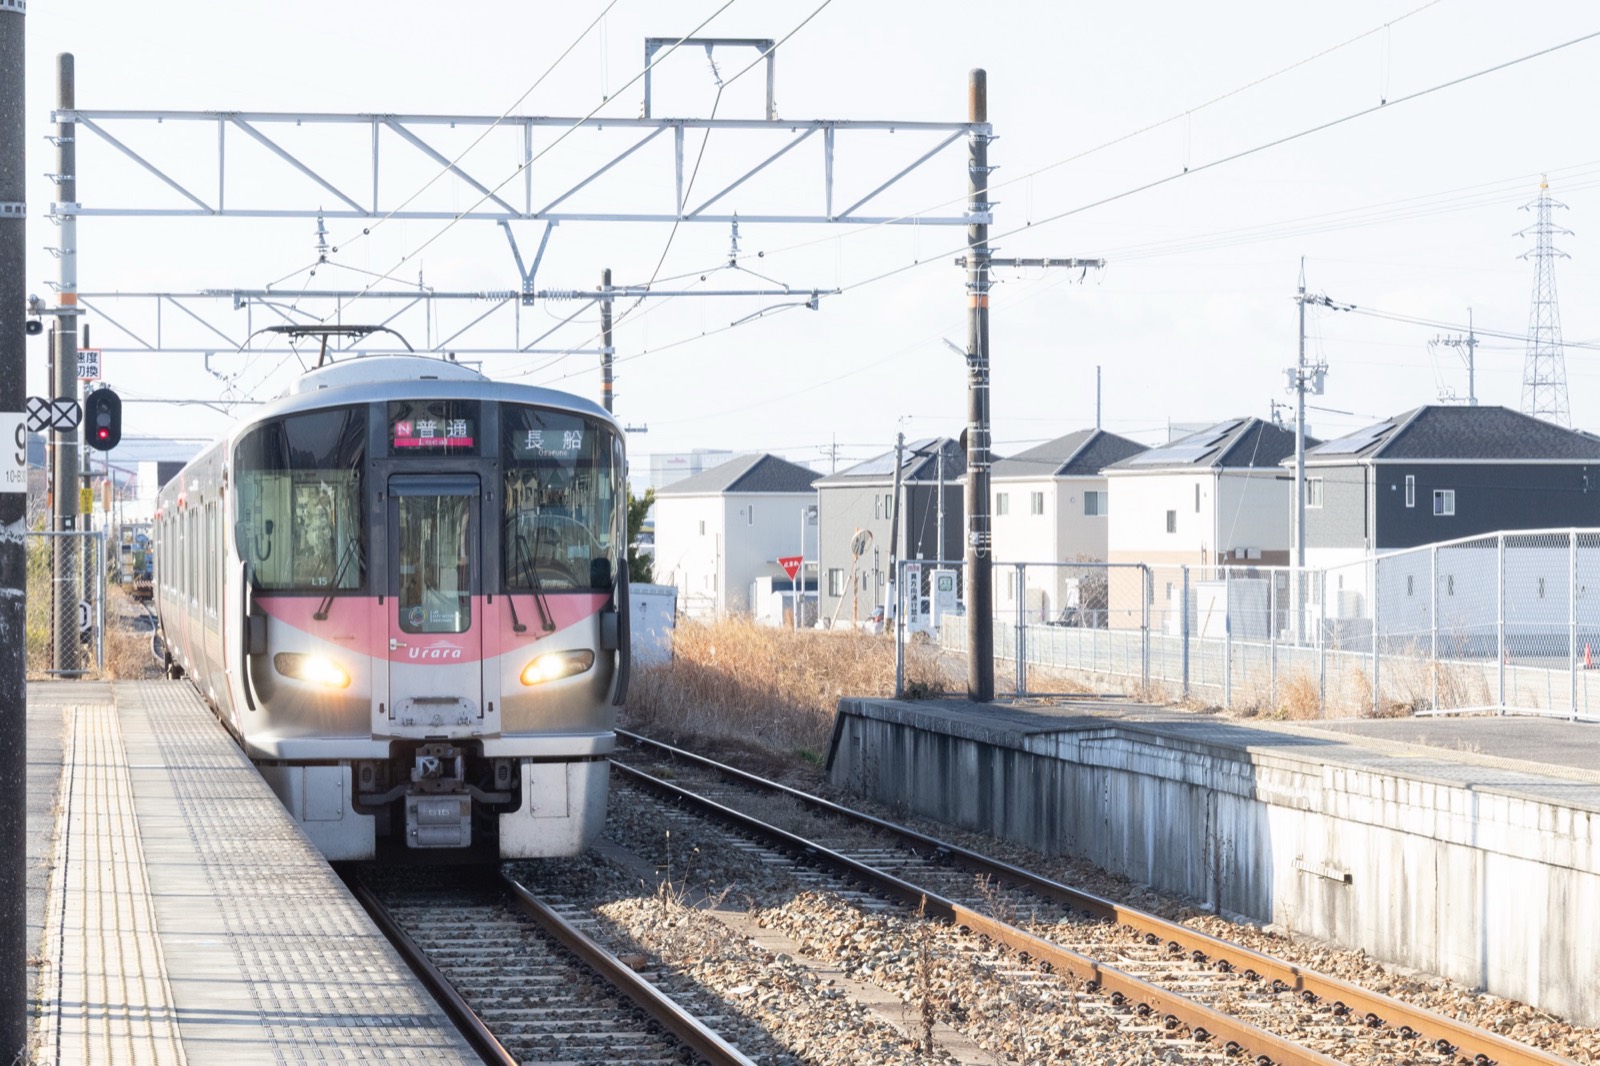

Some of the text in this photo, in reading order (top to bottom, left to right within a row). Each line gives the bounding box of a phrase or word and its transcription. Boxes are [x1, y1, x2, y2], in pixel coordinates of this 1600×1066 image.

[398, 419, 467, 438] N 普通
[15, 423, 26, 467] 9
[419, 438, 448, 446] Local
[525, 429, 582, 450] 長船
[409, 647, 462, 658] Urara
